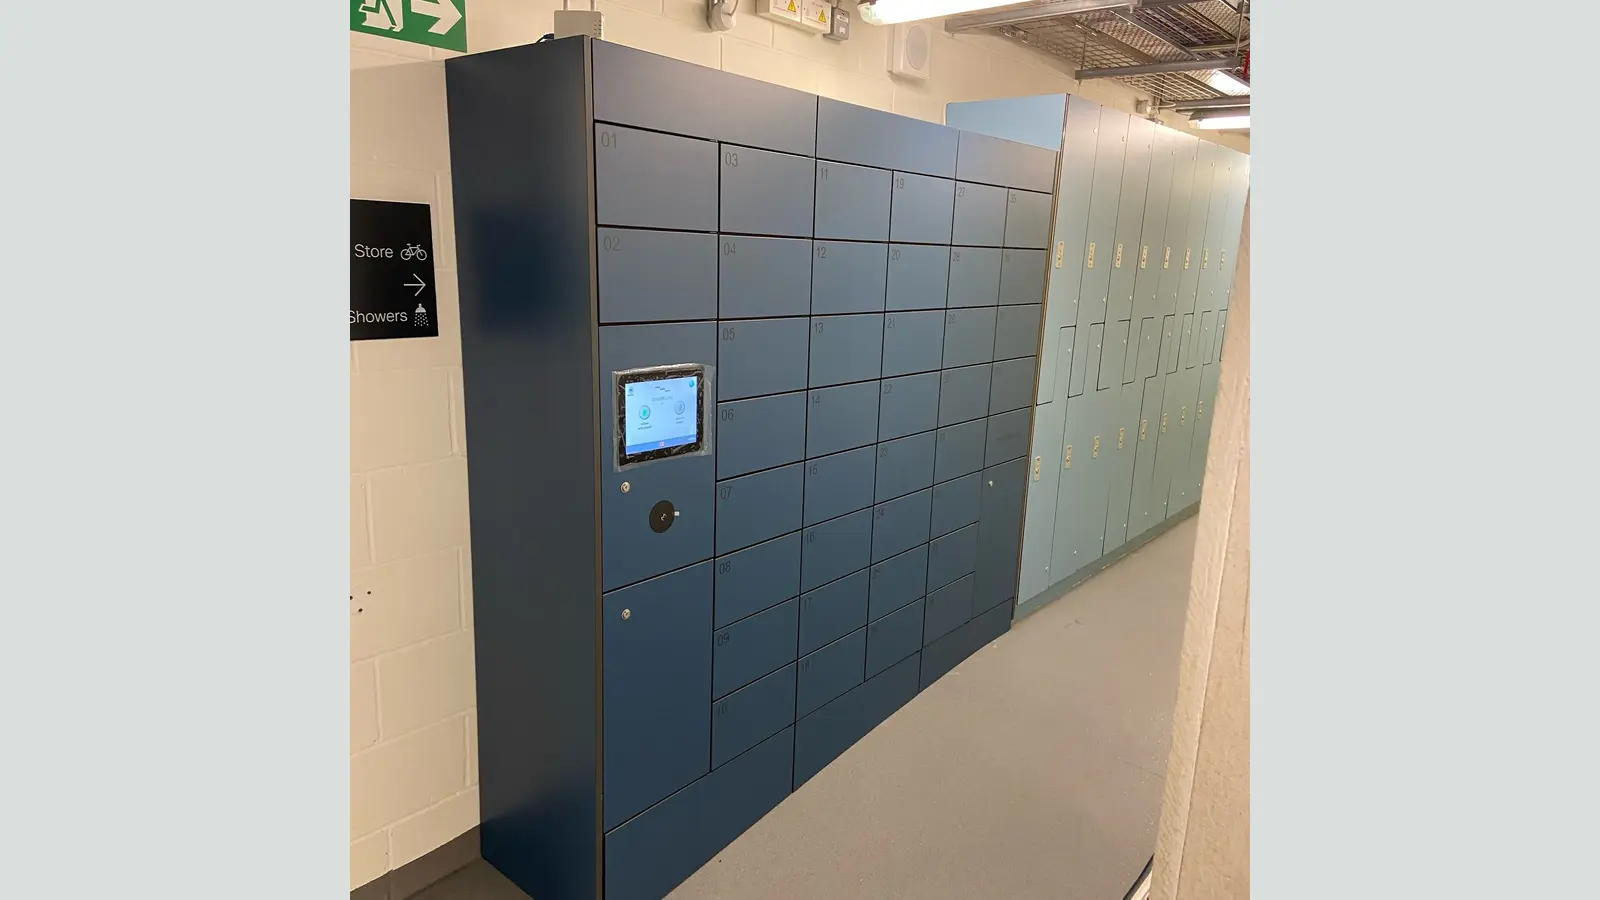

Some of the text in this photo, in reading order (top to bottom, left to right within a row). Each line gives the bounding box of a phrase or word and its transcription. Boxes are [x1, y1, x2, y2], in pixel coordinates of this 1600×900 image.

[601, 131, 617, 149] 01
[724, 152, 739, 168] 03
[819, 168, 829, 180] 11
[895, 177, 904, 189] 19
[354, 243, 394, 258] Store
[603, 236, 620, 252] 02
[723, 242, 736, 257] 04
[815, 246, 826, 259] 12
[891, 249, 900, 261] 20
[350, 309, 408, 324] Showers
[887, 317, 895, 329] 21
[722, 327, 735, 341] 05
[812, 322, 824, 334] 13
[884, 383, 892, 394] 22
[811, 394, 820, 406] 14
[721, 408, 734, 421] 06
[808, 464, 818, 476] 15
[720, 487, 732, 499] 07
[719, 561, 731, 574] 08
[717, 632, 729, 647] 09
[715, 702, 727, 716] 10
